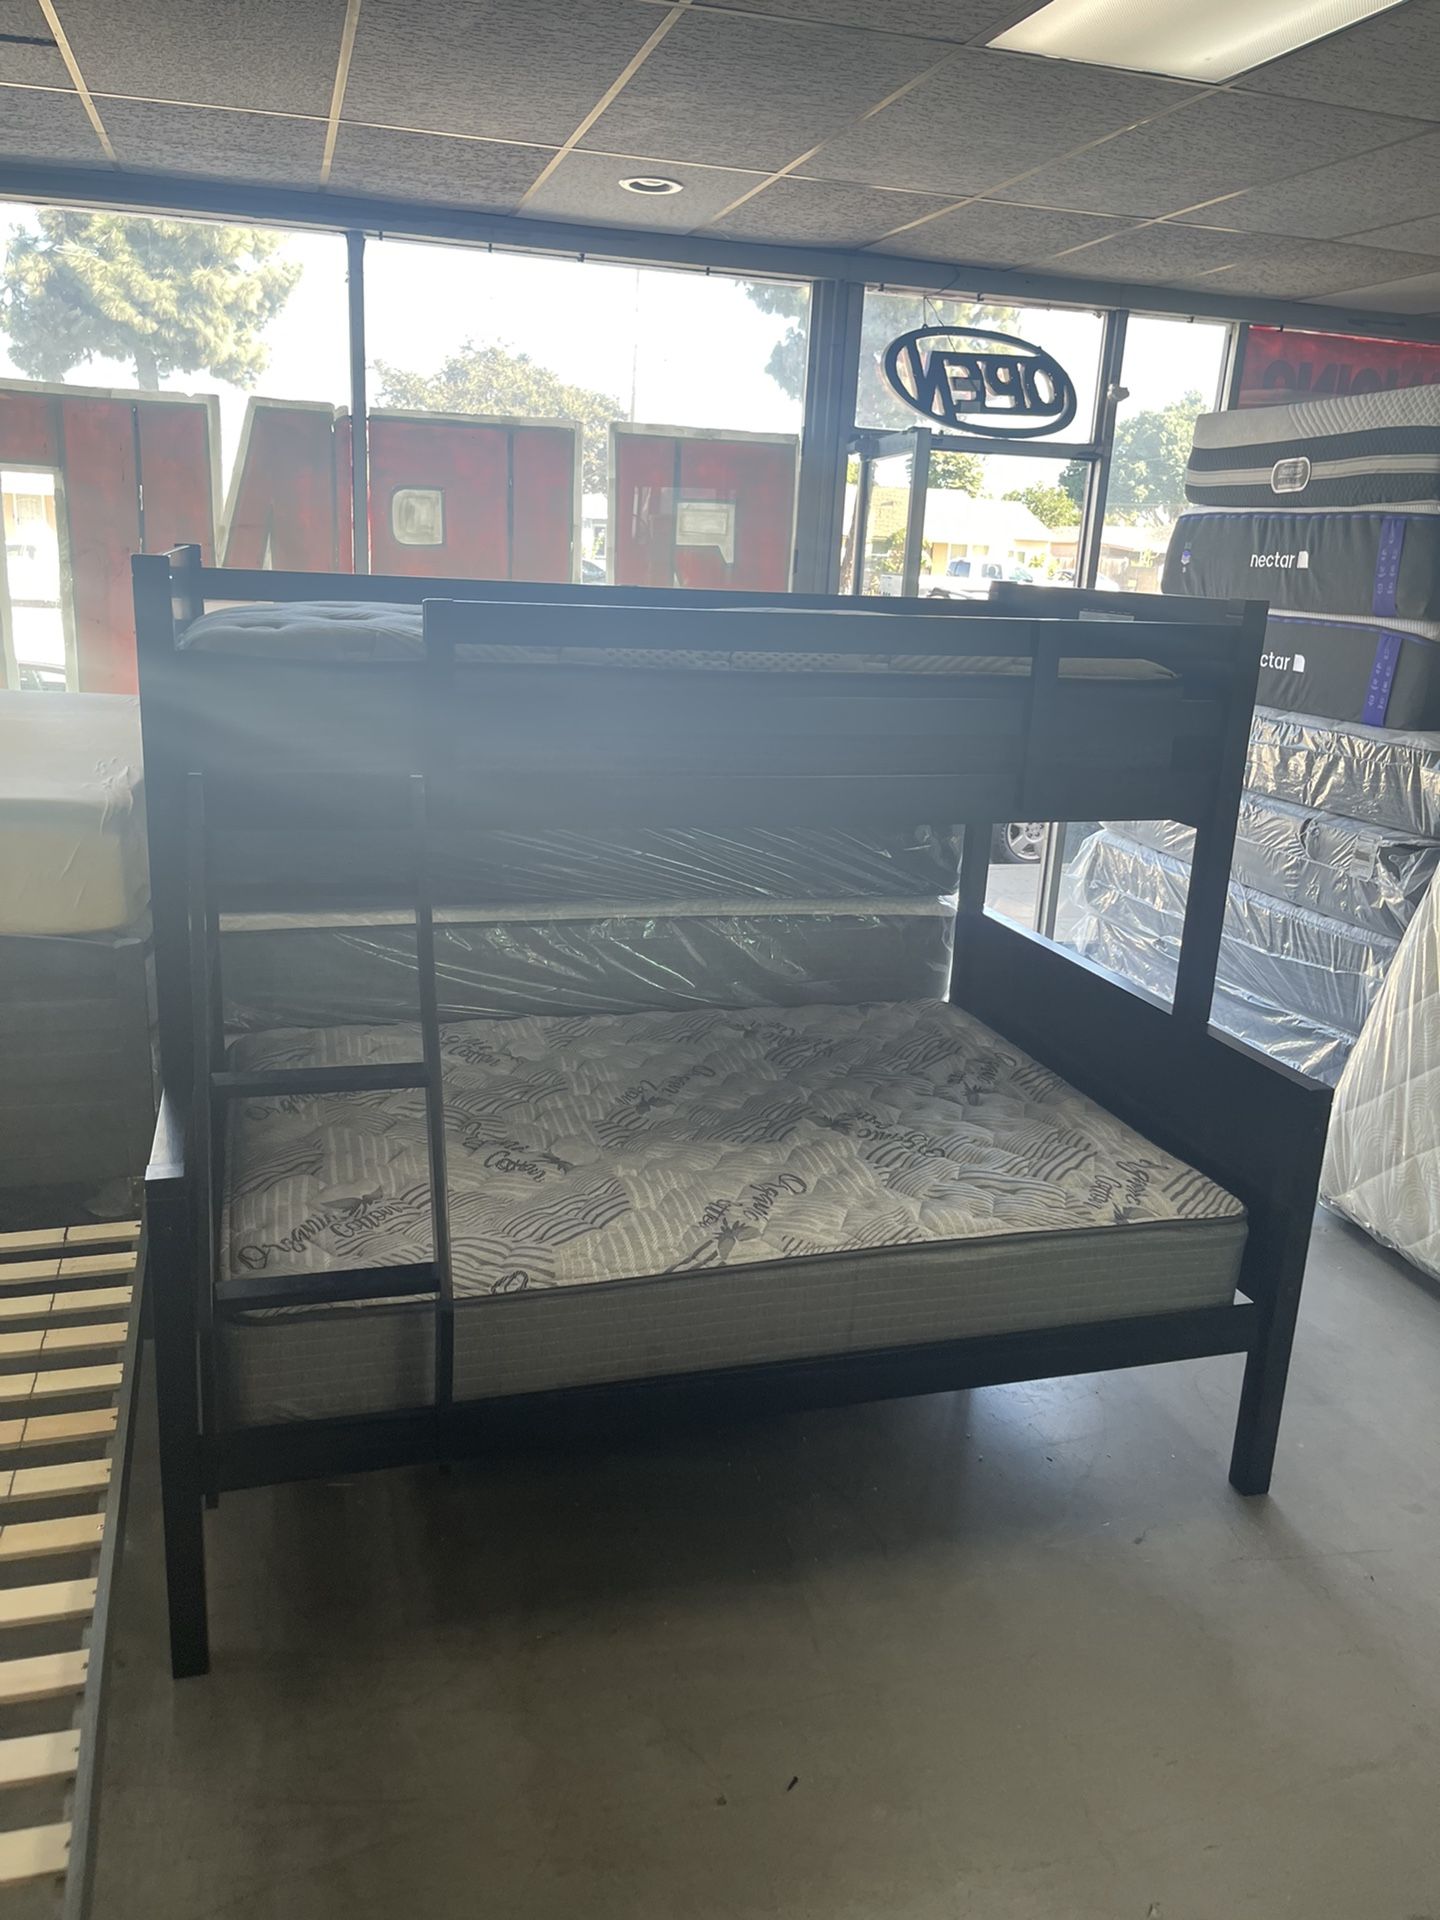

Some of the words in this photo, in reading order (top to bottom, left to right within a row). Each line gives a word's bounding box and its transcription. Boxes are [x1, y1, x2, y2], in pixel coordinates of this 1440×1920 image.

[1250, 552, 1295, 569] nectar
[1259, 652, 1291, 671] ctar
[237, 1212, 336, 1270] Organic
[329, 1203, 404, 1237] Cotton
